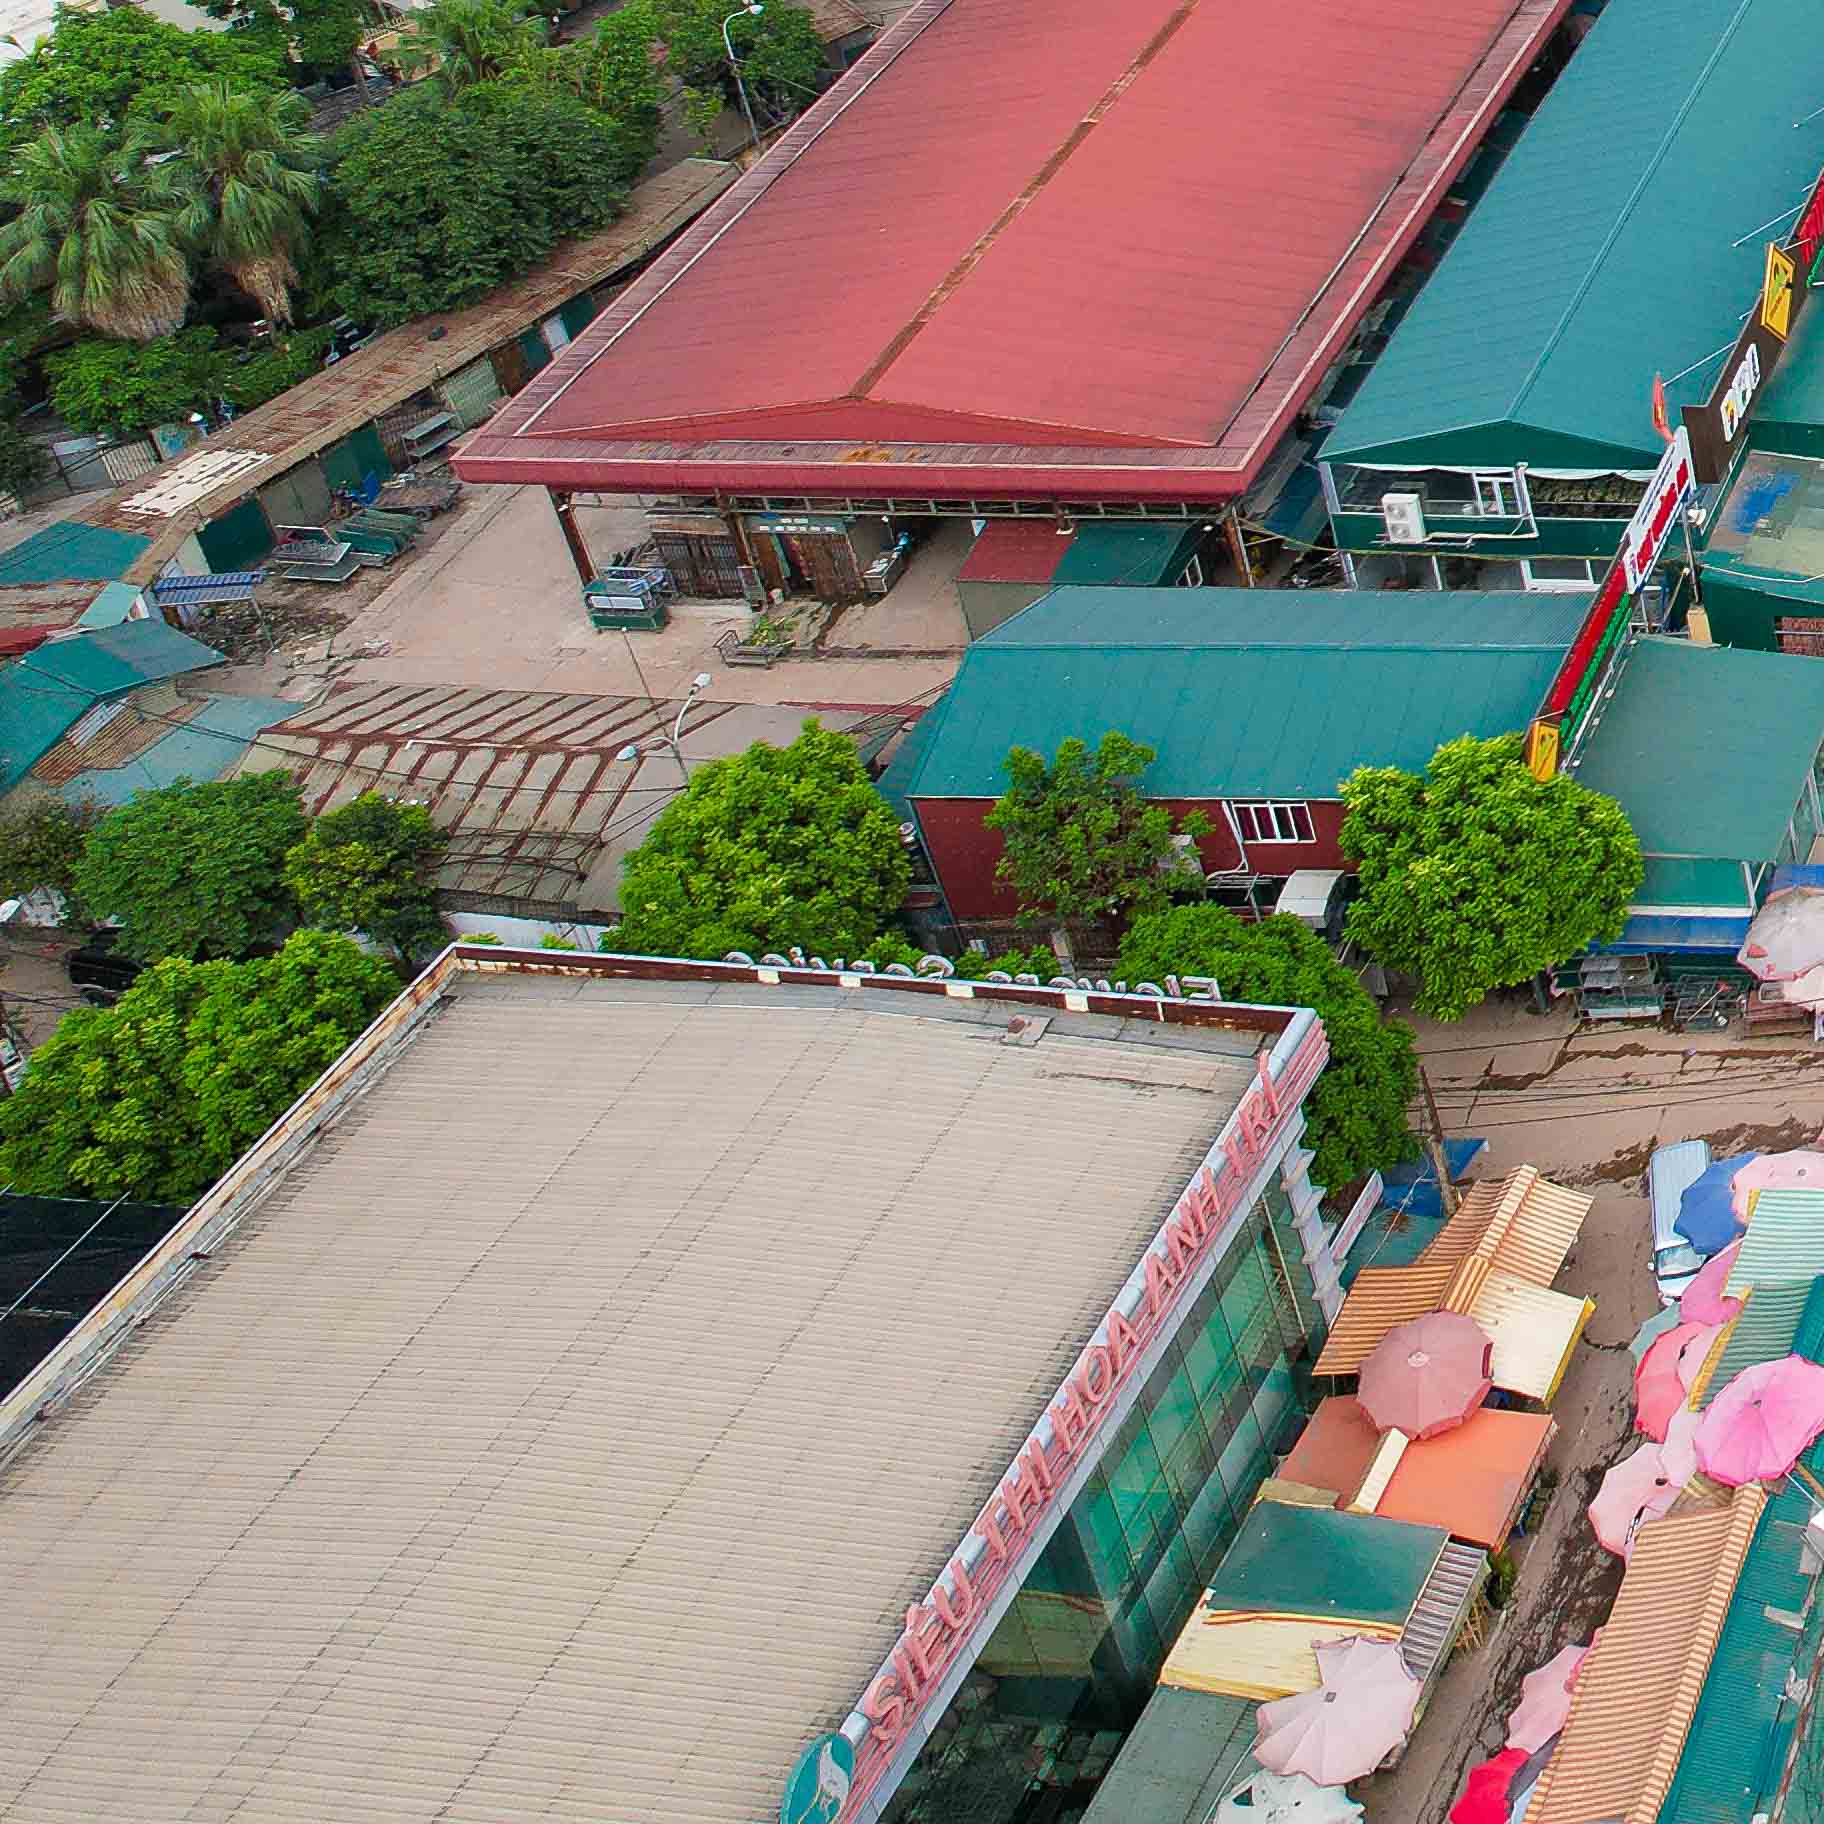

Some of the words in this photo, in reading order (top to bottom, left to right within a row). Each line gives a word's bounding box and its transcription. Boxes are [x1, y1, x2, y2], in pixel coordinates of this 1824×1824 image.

[864, 1558, 974, 1743] SIÊU
[1051, 1311, 1140, 1453] HOA
[1145, 1168, 1221, 1313] ANH
